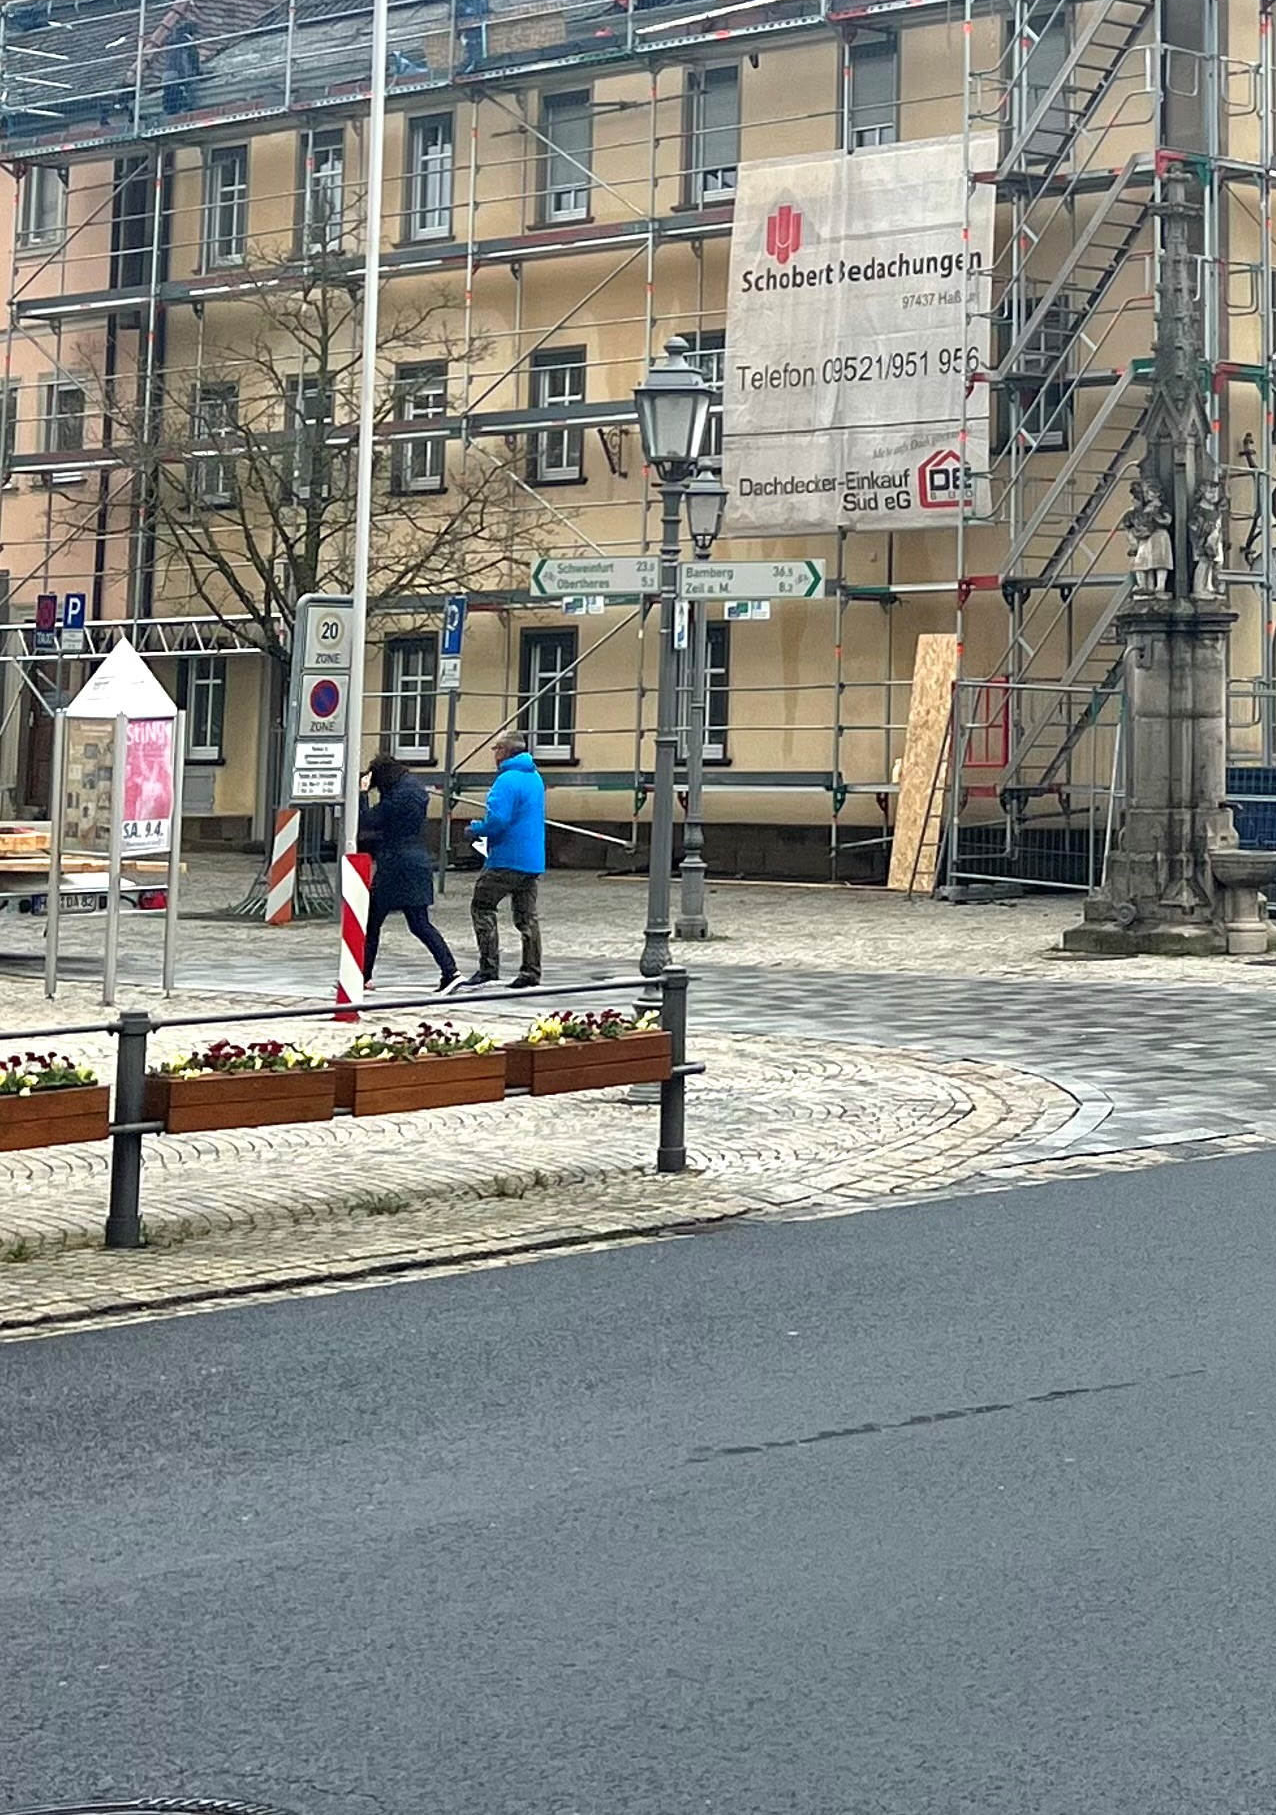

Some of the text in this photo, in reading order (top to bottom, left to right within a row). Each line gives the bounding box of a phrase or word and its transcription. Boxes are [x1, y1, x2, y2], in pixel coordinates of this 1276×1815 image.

[741, 264, 834, 293] Schobert
[902, 293, 935, 310] 97437
[736, 346, 980, 391] Telefon 09521/951 956
[739, 467, 911, 497] Dachdecker-Einkauf
[843, 490, 912, 512] Süd eG
[557, 562, 614, 575] Schweinfurt
[686, 567, 734, 580] Bamberg
[685, 583, 705, 594] Zeil
[719, 583, 732, 594] M.
[67, 597, 81, 625] P
[321, 621, 338, 640] 20
[315, 652, 340, 665] ZONE
[310, 721, 336, 733] ZONE
[123, 822, 141, 839] SA.
